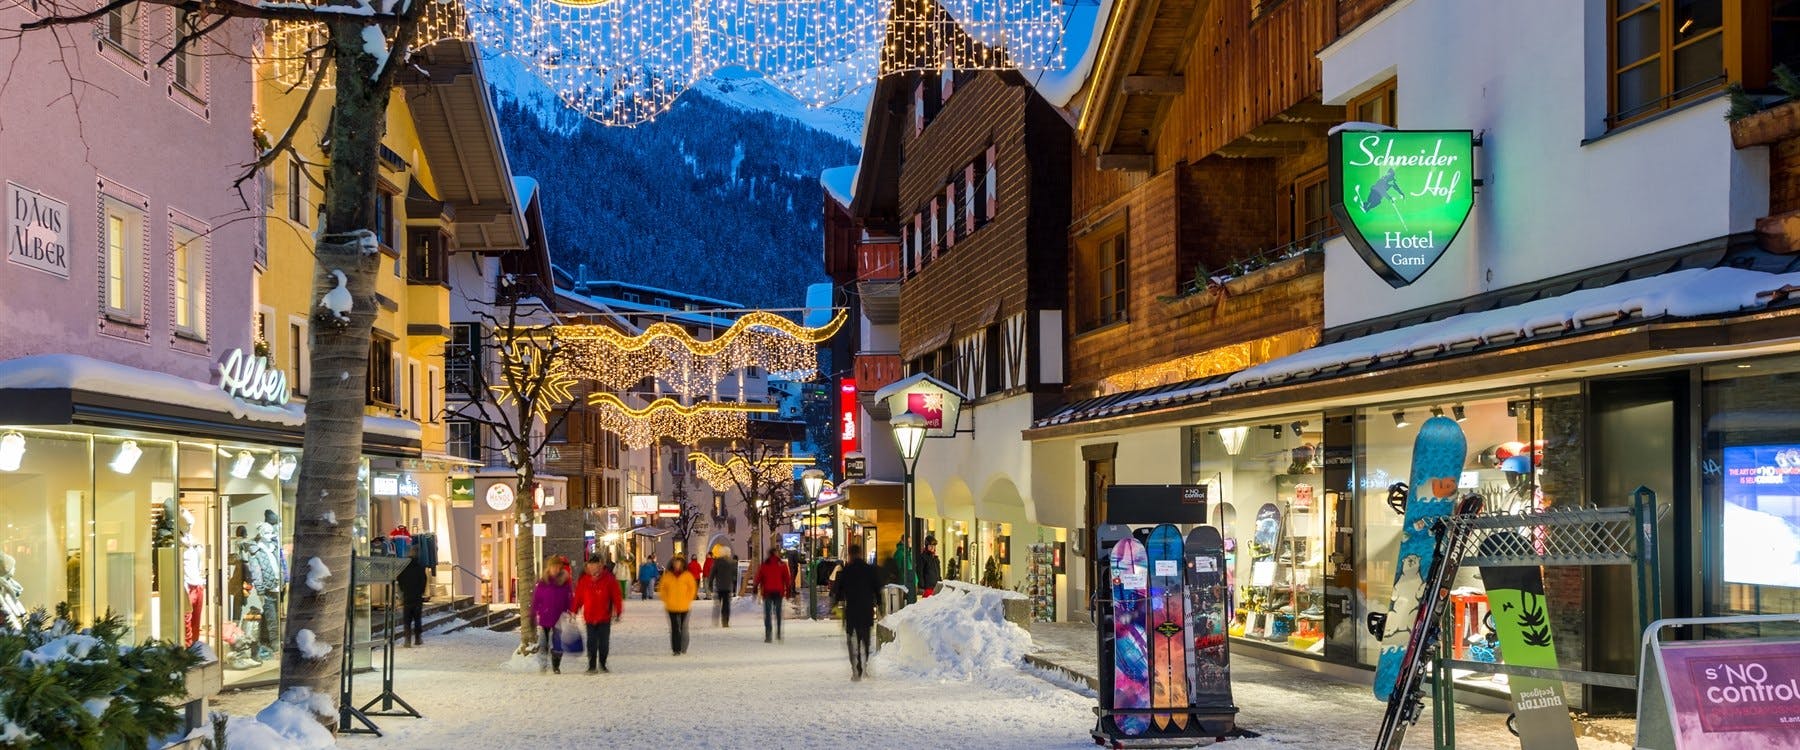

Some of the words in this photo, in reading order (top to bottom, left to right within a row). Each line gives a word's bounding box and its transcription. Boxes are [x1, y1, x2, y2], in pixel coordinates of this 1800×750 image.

[1349, 135, 1457, 167] Schneider
[1410, 170, 1461, 204] Hof
[9, 225, 66, 268] ALBER
[1384, 230, 1434, 249] Hotel
[1391, 253, 1425, 265] Garni
[218, 348, 290, 405] Alber
[1517, 695, 1563, 711] BURTON
[1707, 679, 1800, 704] control
